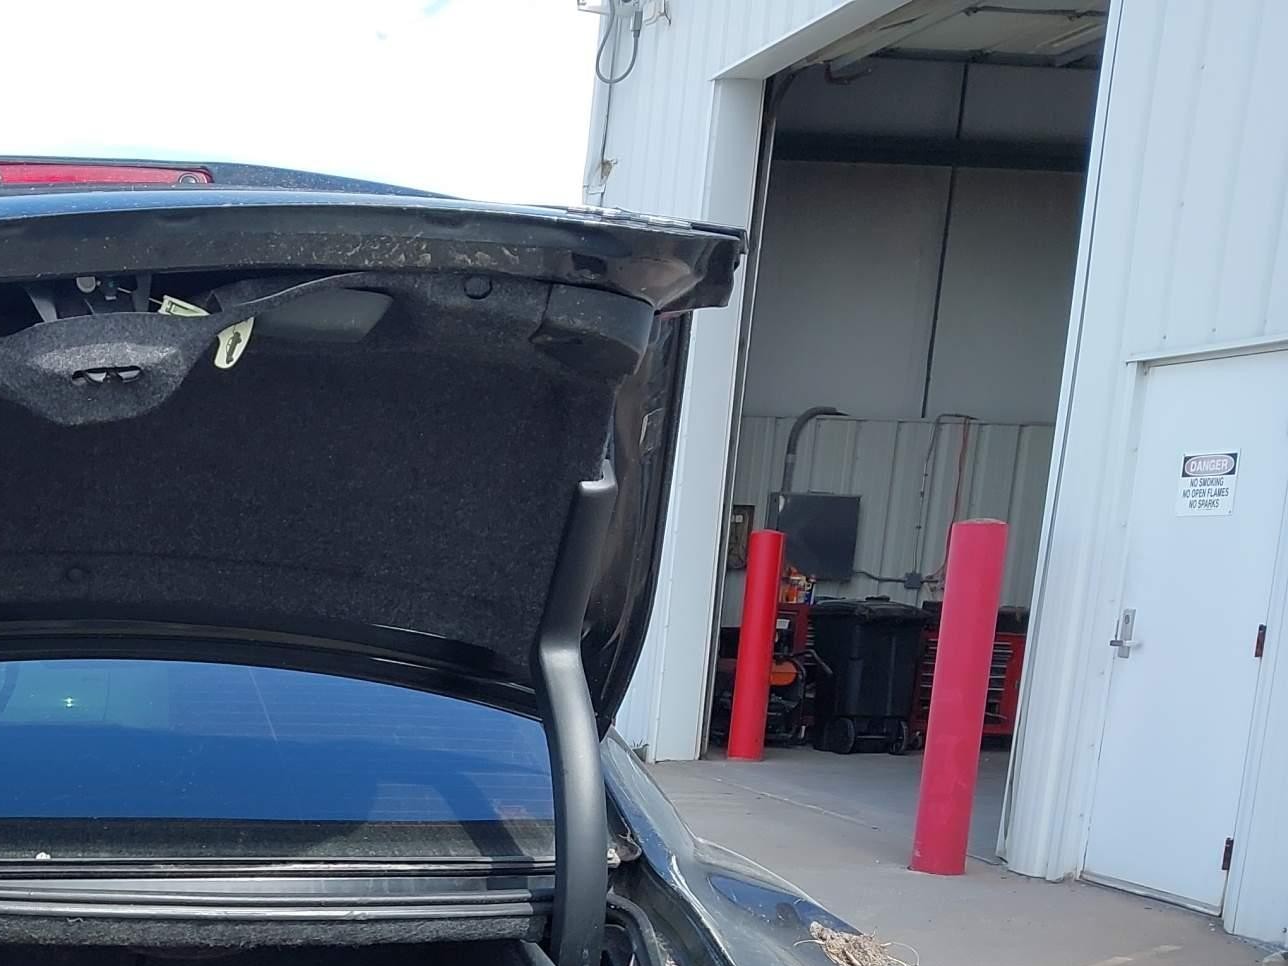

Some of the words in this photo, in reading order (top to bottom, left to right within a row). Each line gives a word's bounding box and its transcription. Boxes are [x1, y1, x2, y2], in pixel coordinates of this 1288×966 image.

[1190, 459, 1228, 472] DANGER
[1190, 478, 1199, 487] NO
[1199, 477, 1224, 487] SMOKING
[1182, 489, 1190, 498] NO
[1192, 488, 1206, 498] OPEN
[1207, 487, 1229, 497] FLAMES
[1189, 500, 1197, 508] NO
[1198, 499, 1219, 508] SPARKS
